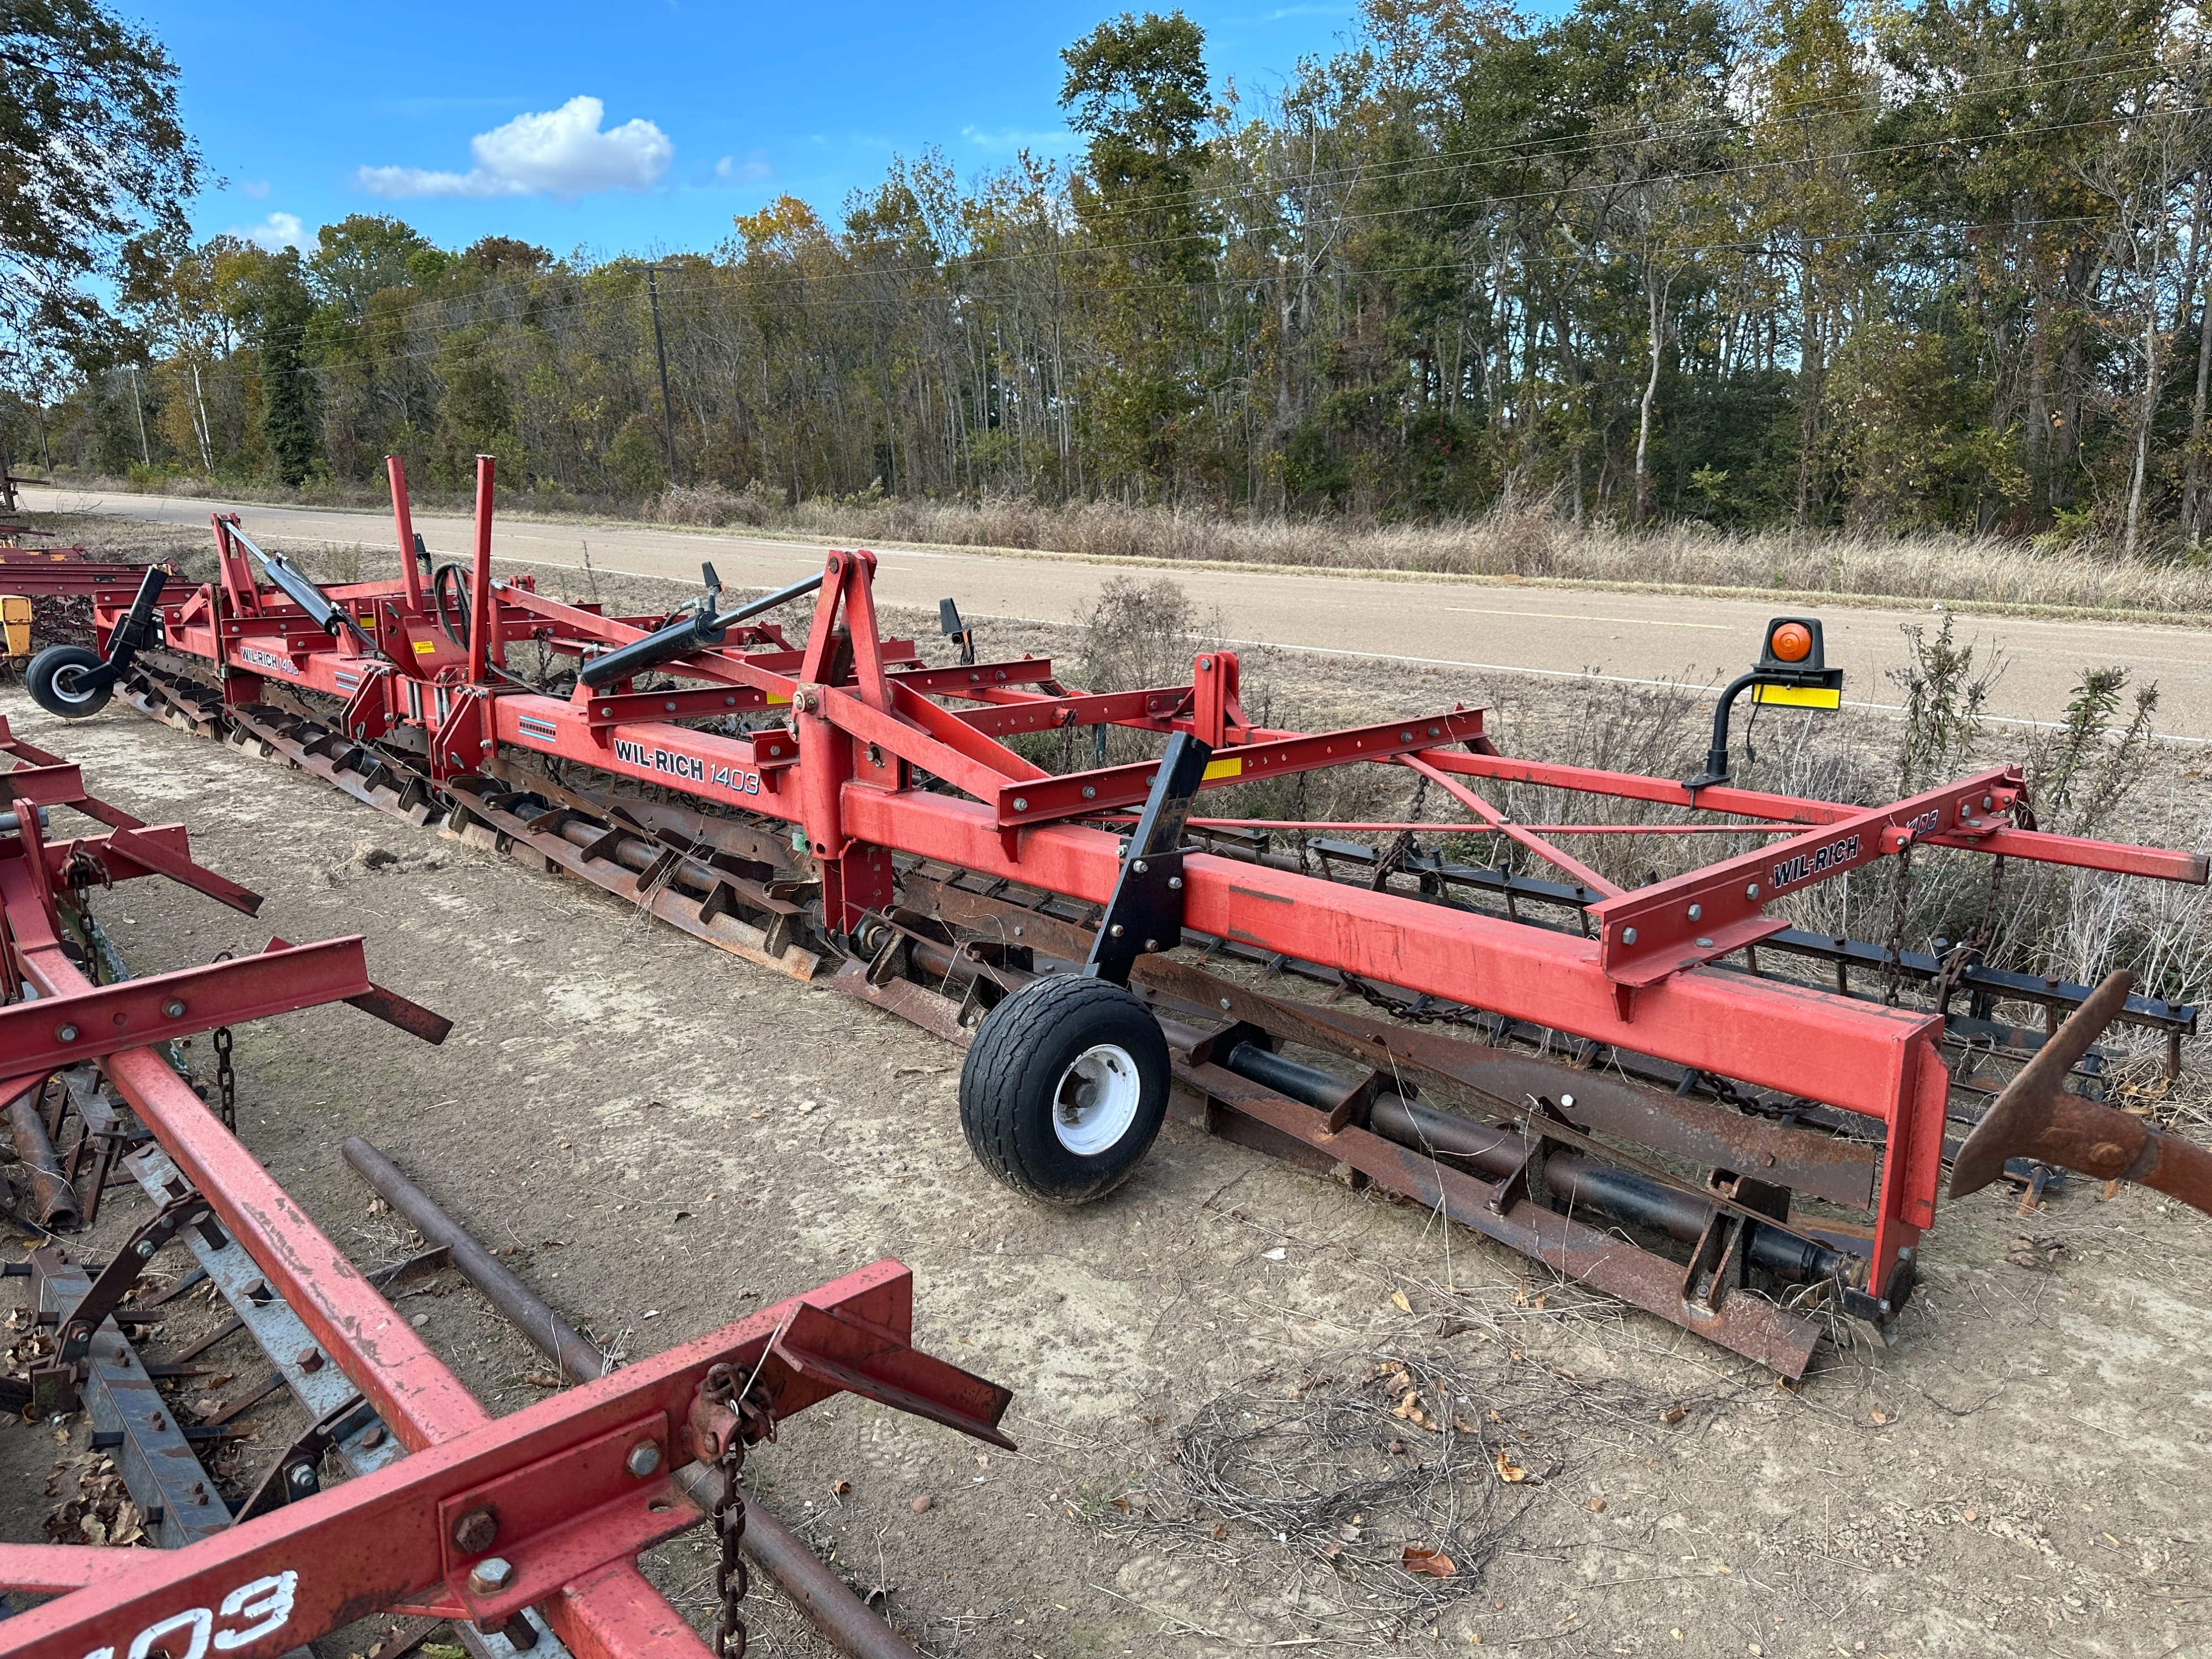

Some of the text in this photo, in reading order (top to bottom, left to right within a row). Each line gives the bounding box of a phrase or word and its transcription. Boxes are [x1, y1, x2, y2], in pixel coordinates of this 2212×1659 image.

[240, 646, 278, 670] WIL-RICH
[613, 738, 759, 794] WIL-RICH 1403
[1773, 809, 1938, 889] WIL-RICH 403
[81, 1570, 298, 1659] 03
